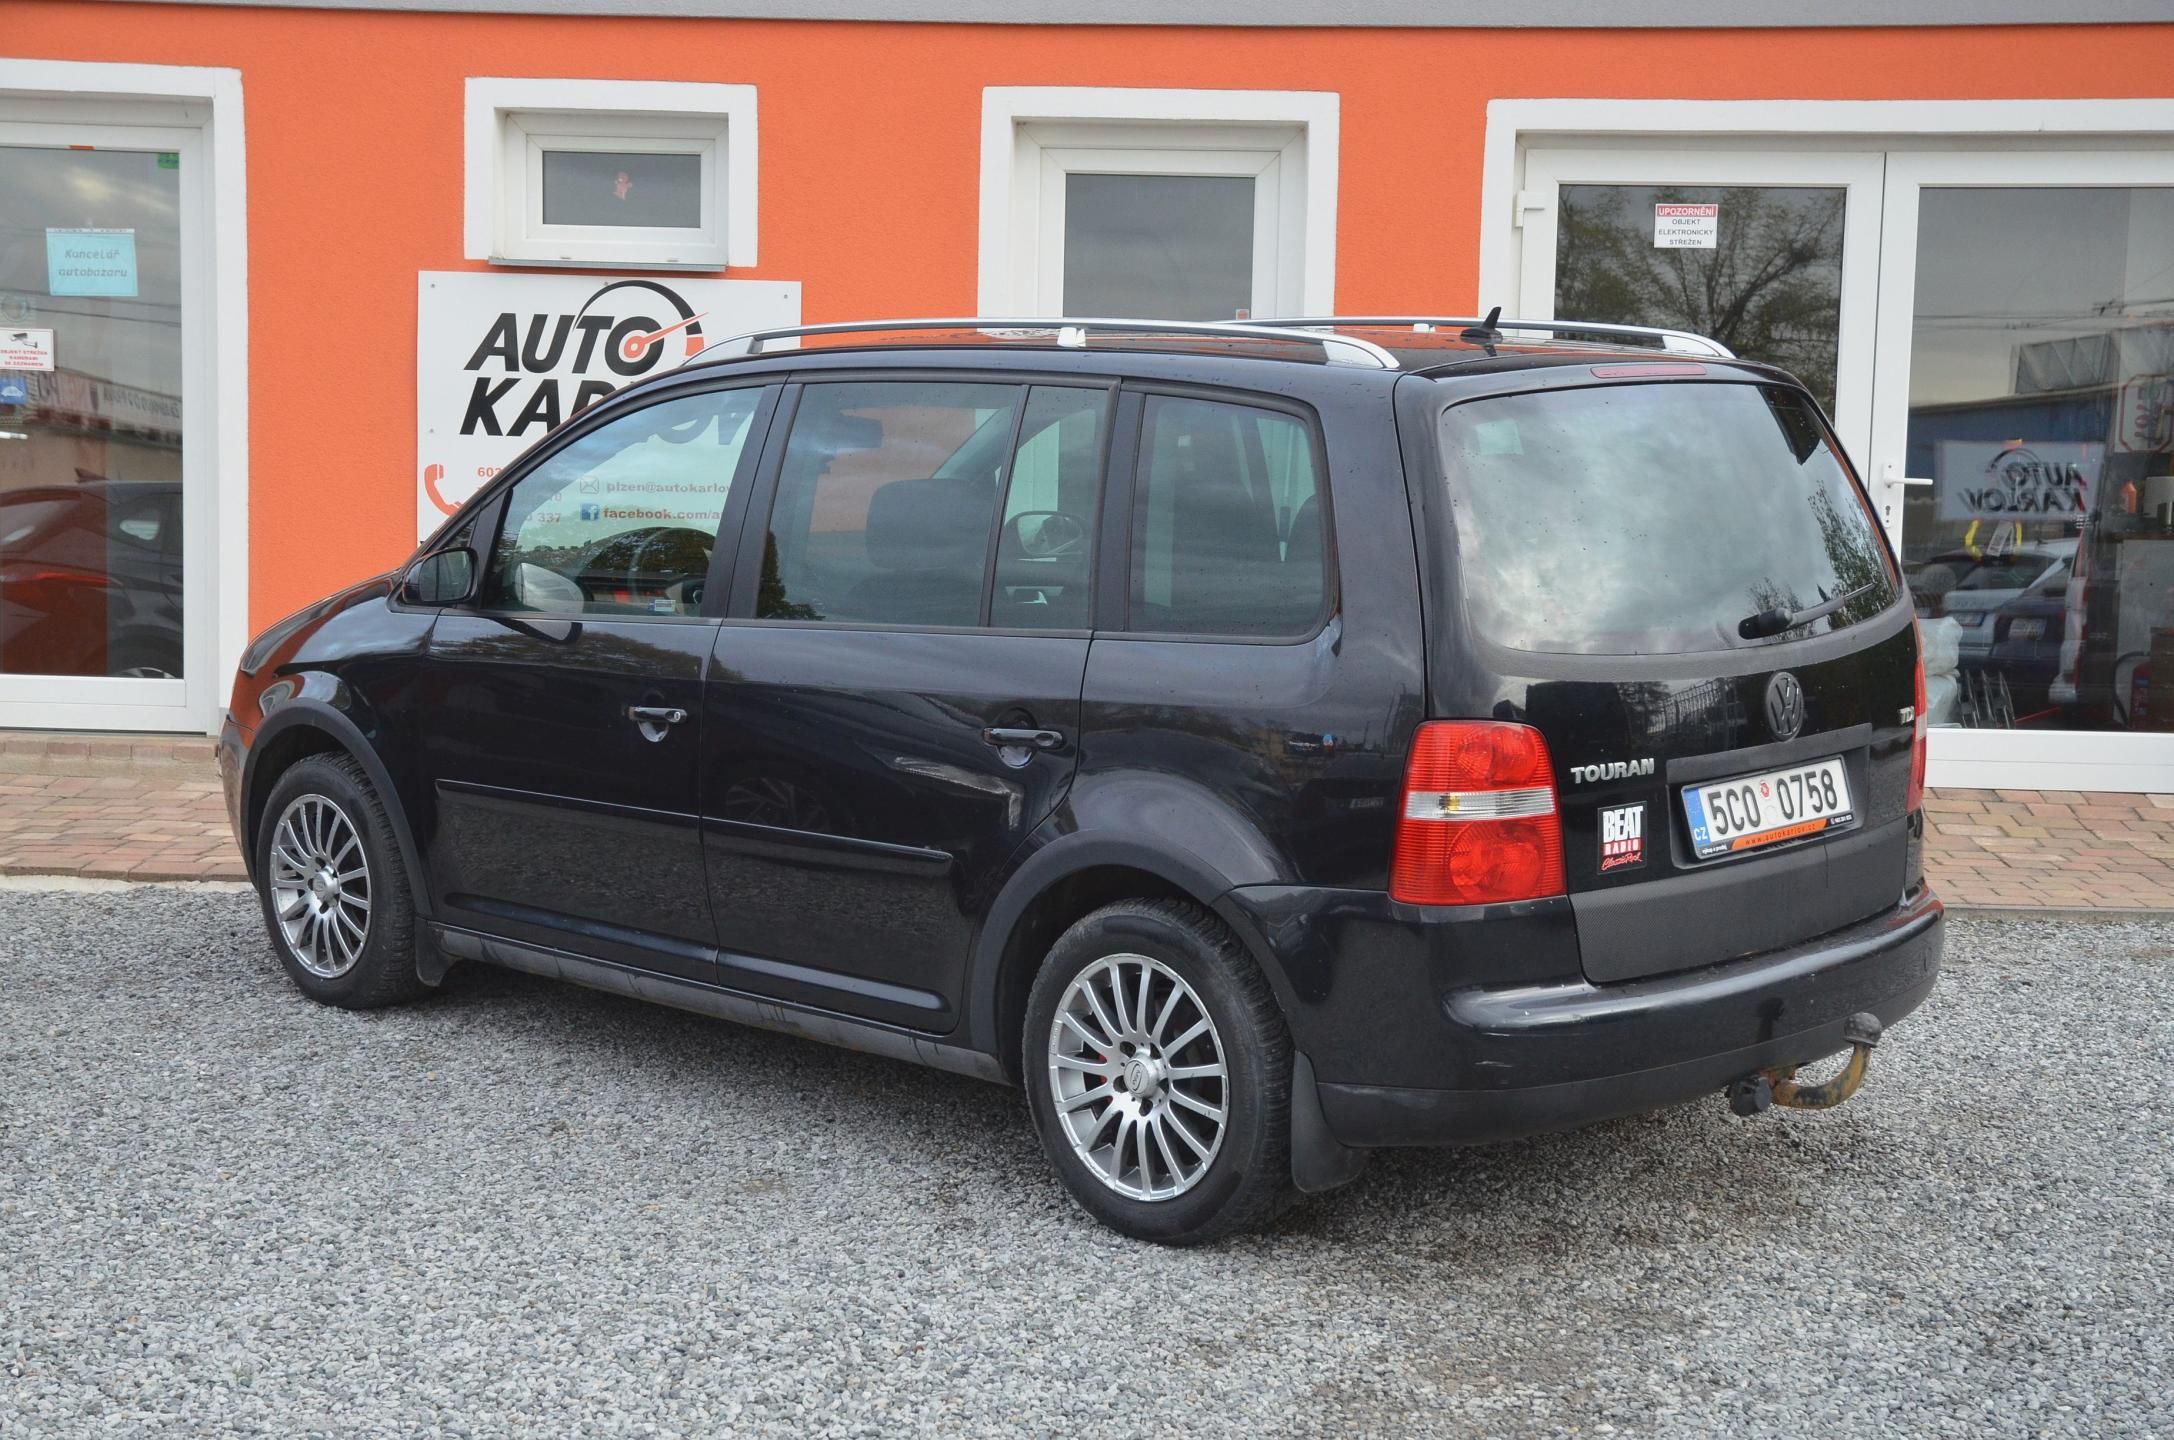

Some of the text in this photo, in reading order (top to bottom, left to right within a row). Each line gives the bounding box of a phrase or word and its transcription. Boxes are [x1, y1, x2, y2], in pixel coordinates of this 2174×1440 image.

[1658, 207, 1714, 216] UPOZORNĚNÍ
[64, 248, 121, 260] Kancelář
[58, 267, 128, 278] autobazaru
[464, 312, 665, 377] AUTO
[607, 482, 730, 494] plzen@autokarlo
[1570, 757, 1655, 784] TOURAN
[1603, 805, 1644, 843] BEAT
[1693, 826, 1708, 841] CZ
[1745, 823, 1816, 845] www.autokarlov.cz
[1604, 838, 1640, 856] RADIO
